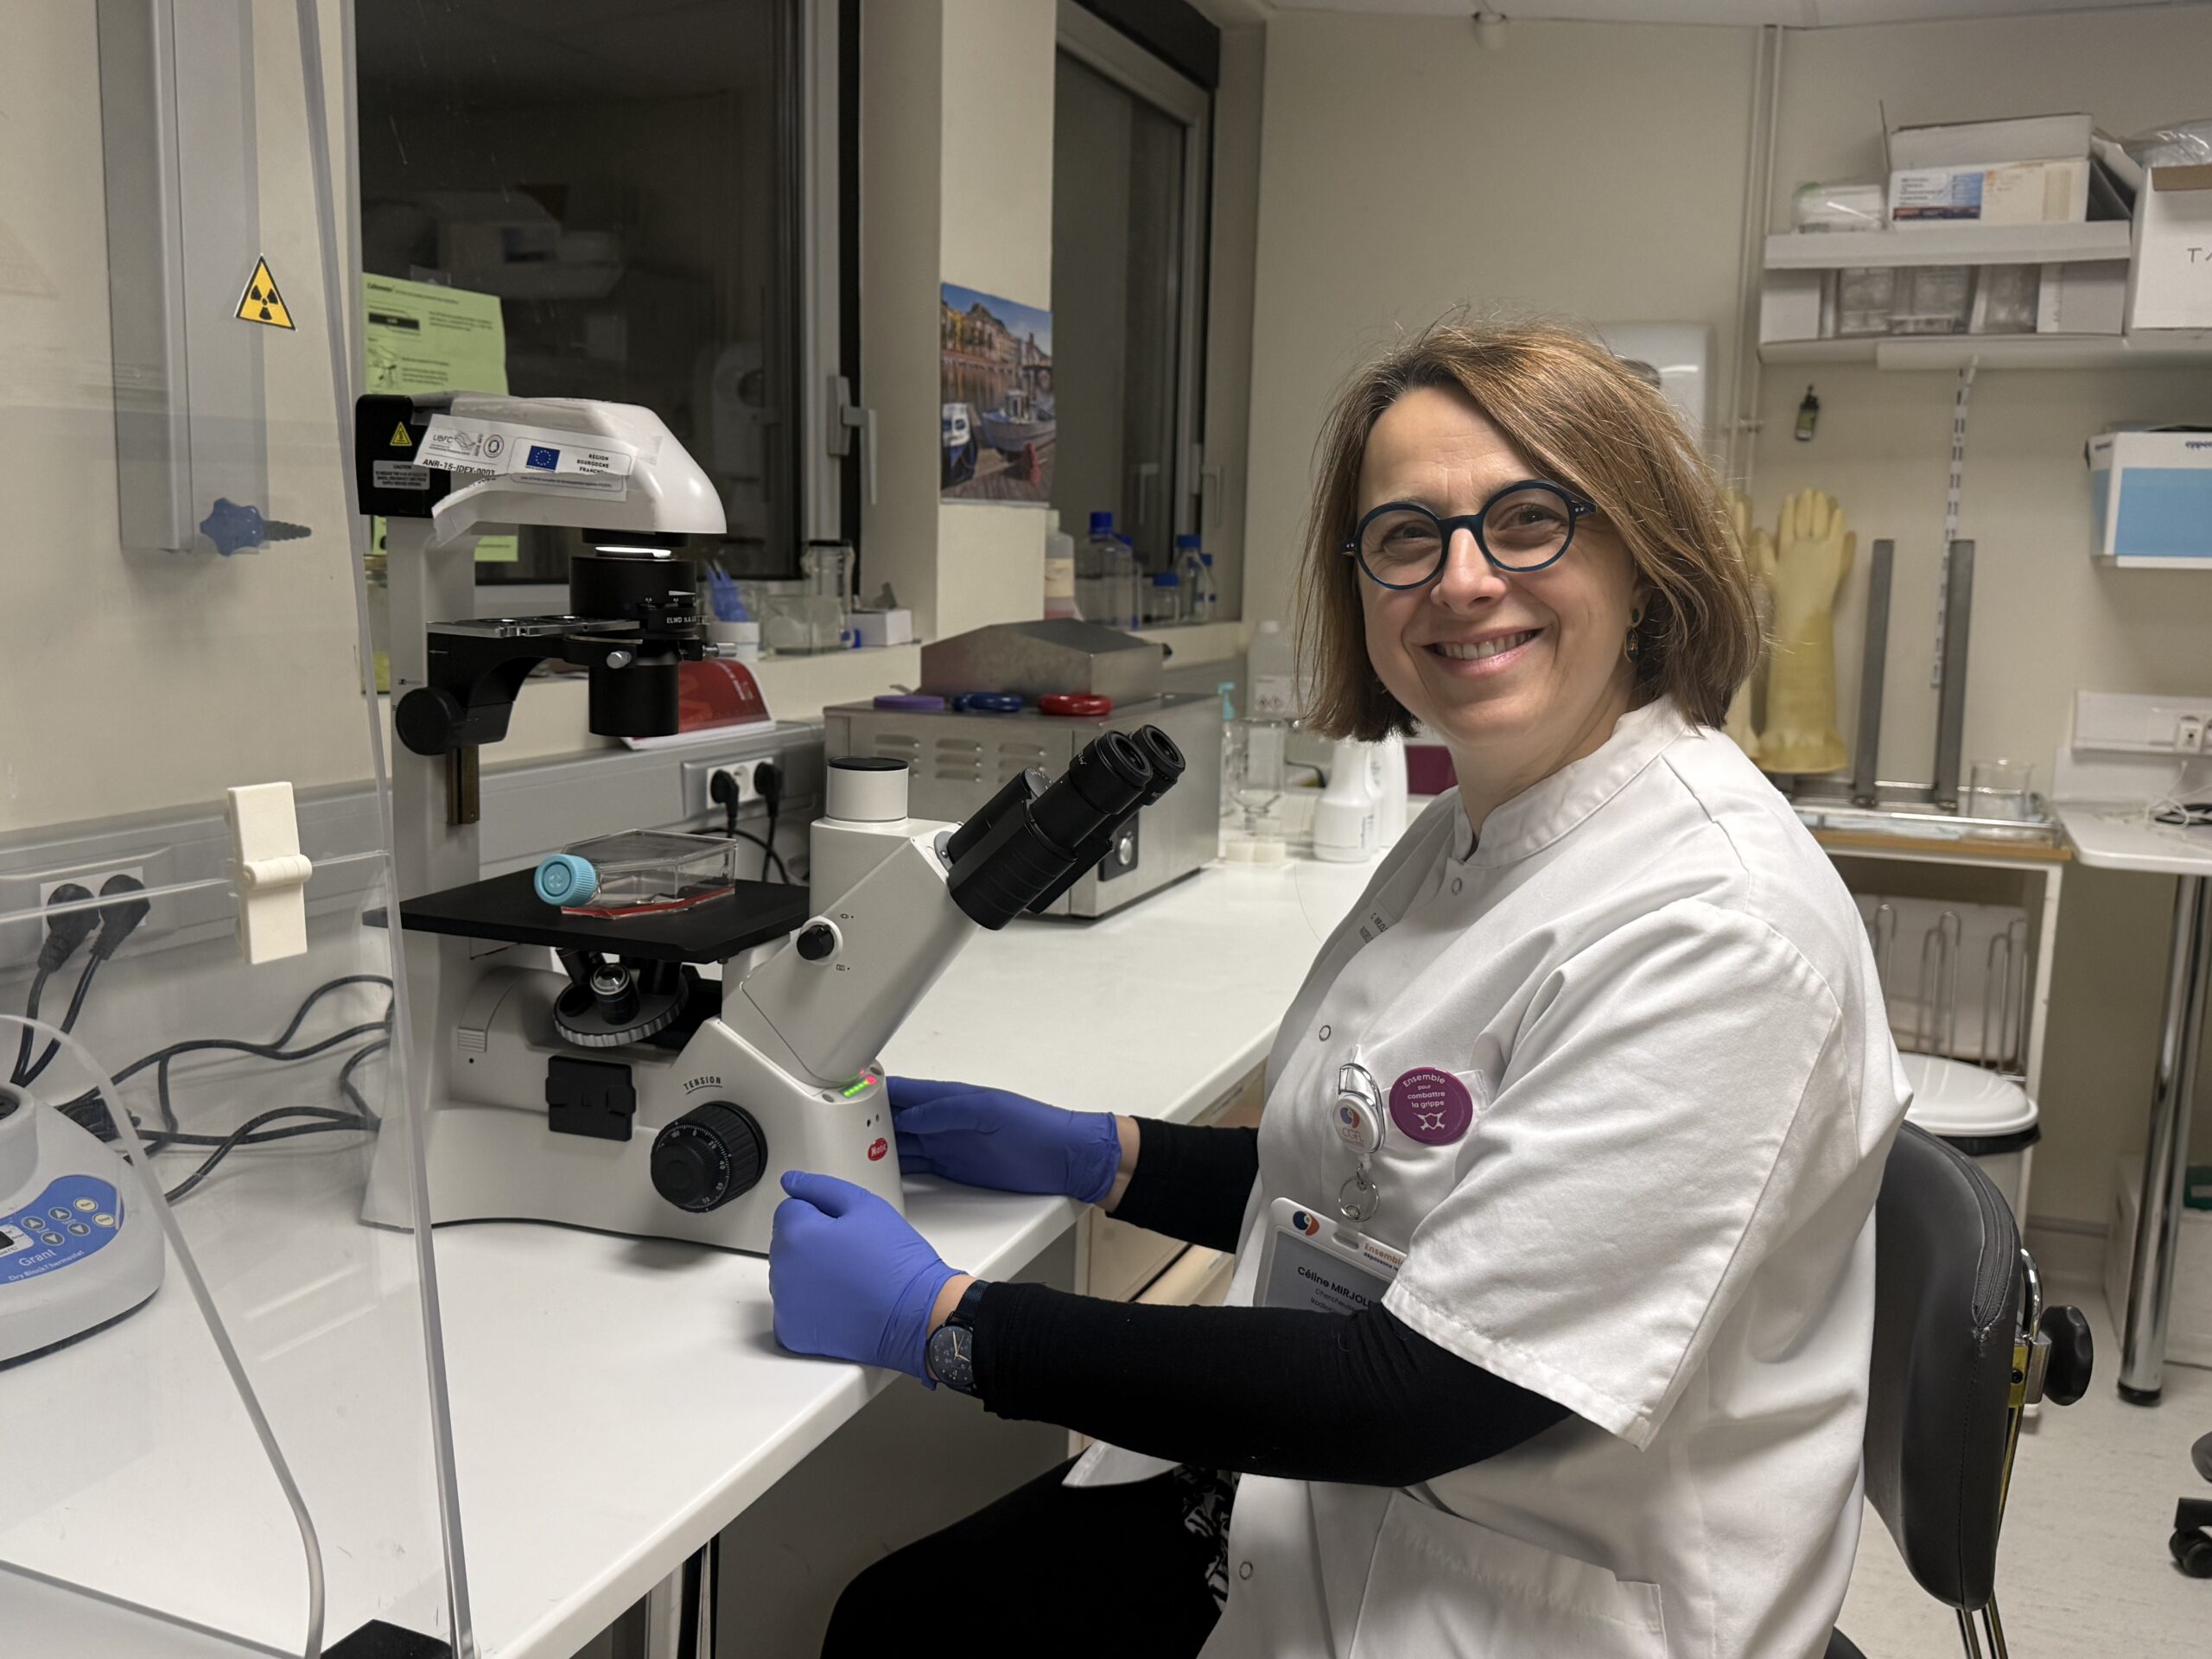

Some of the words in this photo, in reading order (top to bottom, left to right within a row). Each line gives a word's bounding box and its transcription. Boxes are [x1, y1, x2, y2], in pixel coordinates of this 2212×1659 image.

[683, 1076, 721, 1090] TENSION
[1402, 1073, 1446, 1087] Ensemble
[1407, 1091, 1446, 1100] combattre
[1420, 1100, 1445, 1109] grippe
[708, 1141, 717, 1149] 20
[719, 1160, 727, 1170] 40
[19, 1249, 56, 1267] Grant
[8, 1272, 24, 1281] Dry
[1297, 1266, 1330, 1287] Céline
